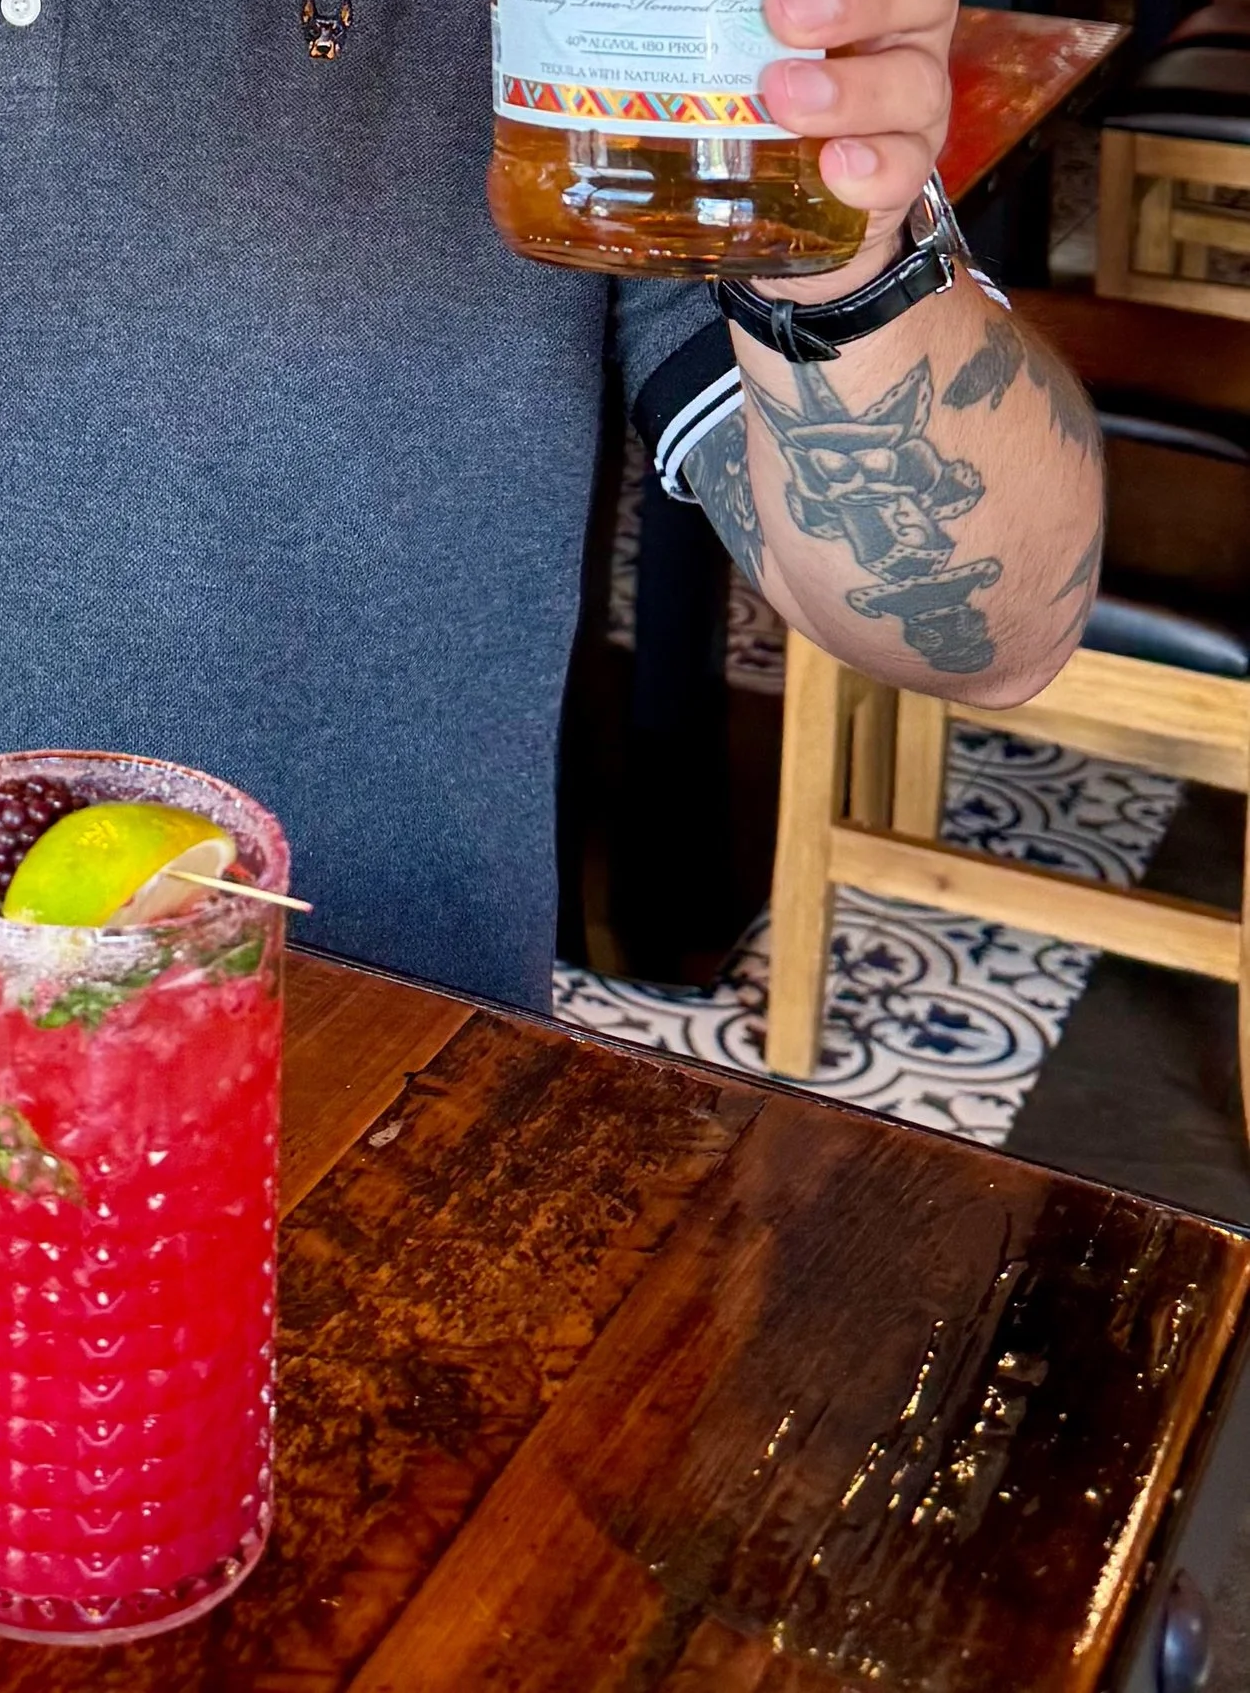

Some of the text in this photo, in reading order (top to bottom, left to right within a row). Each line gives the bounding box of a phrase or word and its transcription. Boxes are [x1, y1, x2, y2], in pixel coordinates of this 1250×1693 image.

[668, 41, 719, 55] PROO)
[540, 61, 753, 85] TEQUILA WITH NATURAL FLAVORS
